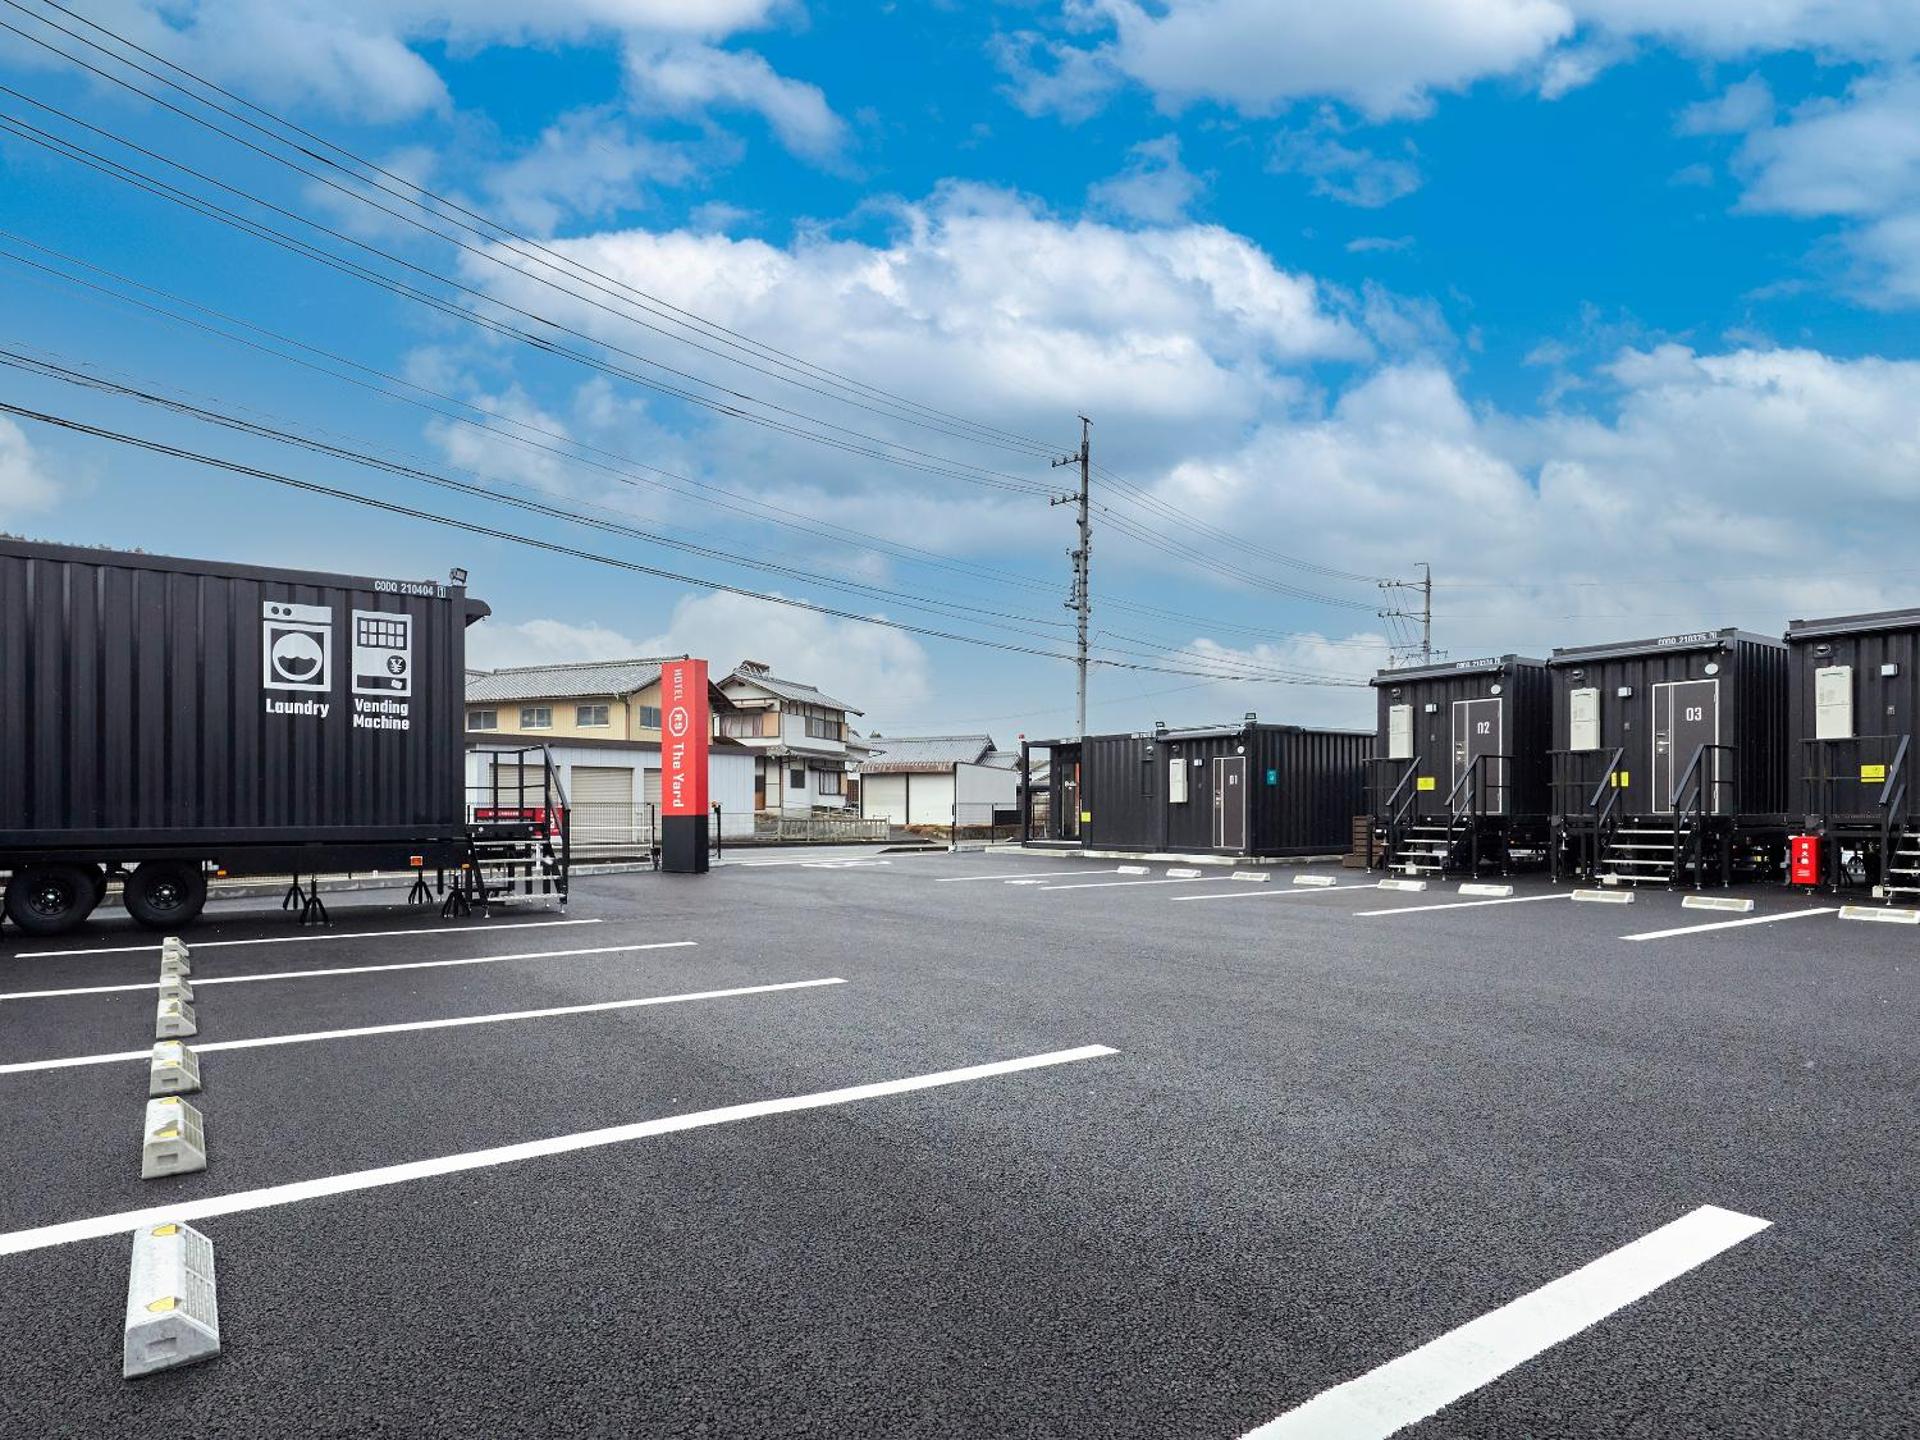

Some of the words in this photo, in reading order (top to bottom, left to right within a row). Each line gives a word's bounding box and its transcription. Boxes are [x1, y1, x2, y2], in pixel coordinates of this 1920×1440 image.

[674, 668, 682, 701] HOTEL
[266, 698, 330, 718] Laundry
[354, 698, 409, 716] Vending
[1686, 707, 1702, 721] 03
[353, 714, 410, 730] Machine
[1477, 722, 1491, 734] 02
[673, 742, 684, 769] The
[673, 773, 684, 808] Yard
